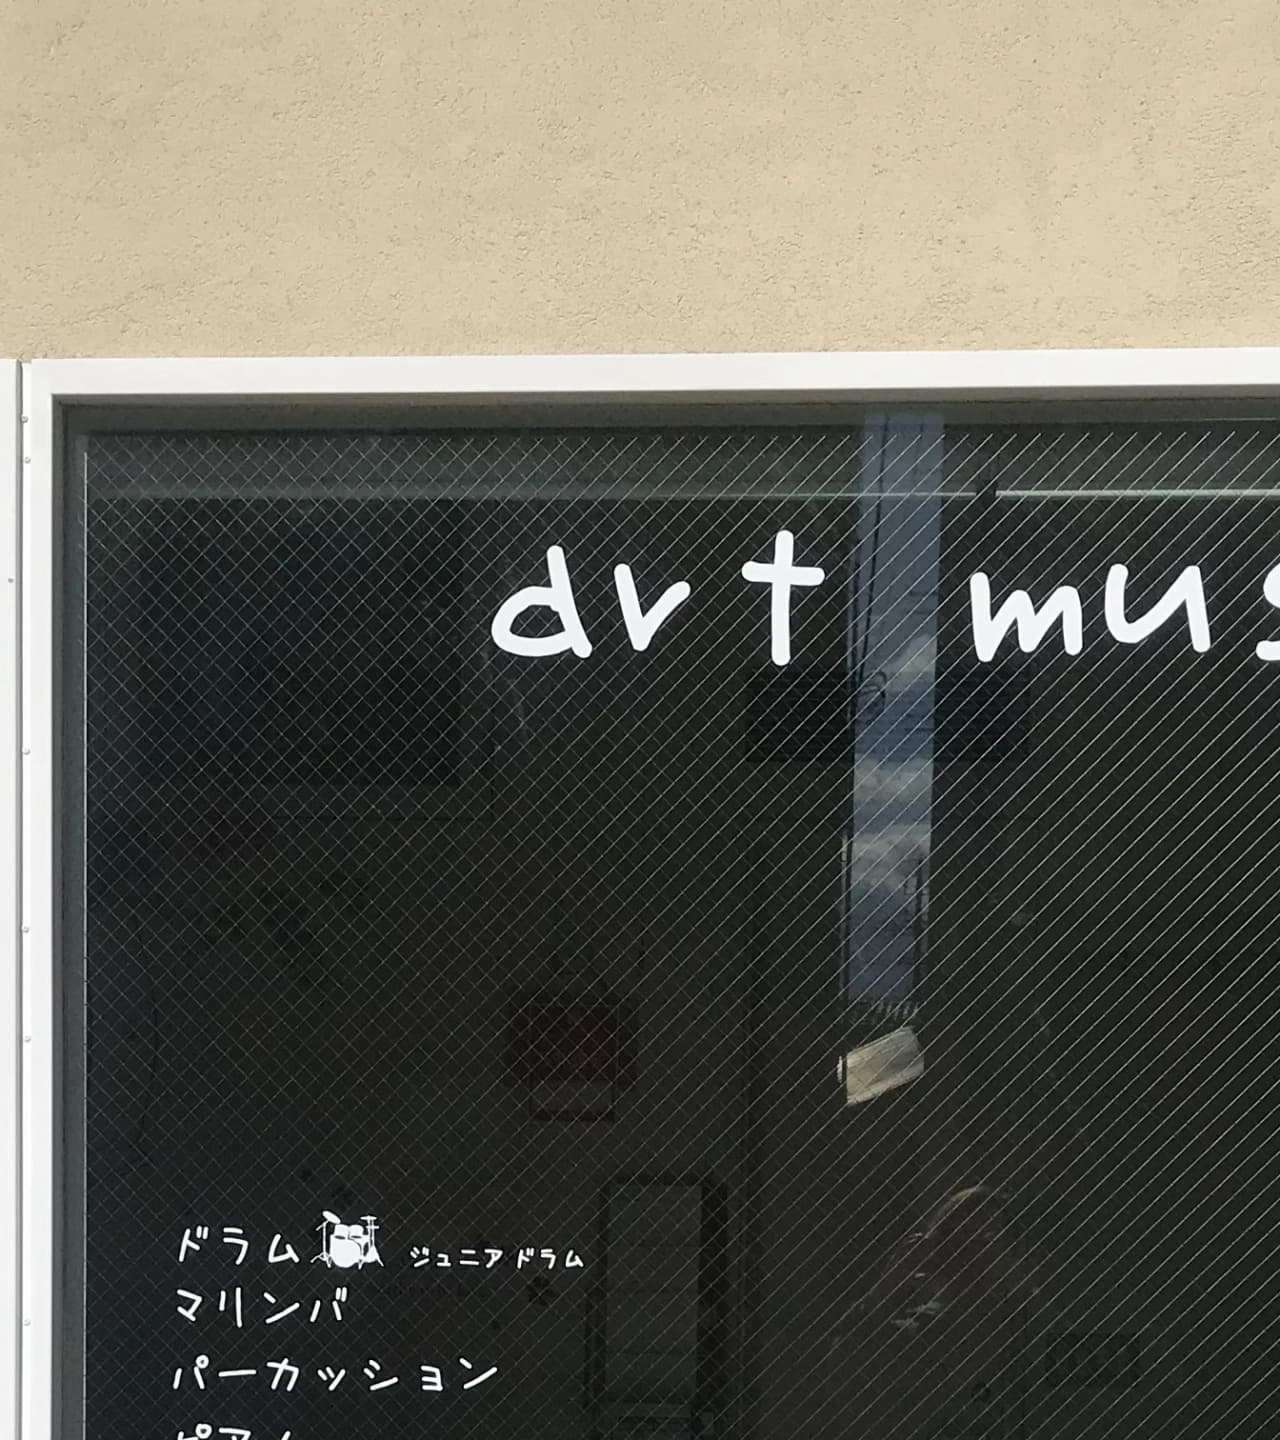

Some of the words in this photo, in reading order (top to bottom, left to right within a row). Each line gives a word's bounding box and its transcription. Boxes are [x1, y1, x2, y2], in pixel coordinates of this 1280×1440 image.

[178, 1225, 300, 1265] ドラム
[176, 1286, 347, 1328] マリンバ
[173, 1354, 498, 1392] パーカッション
